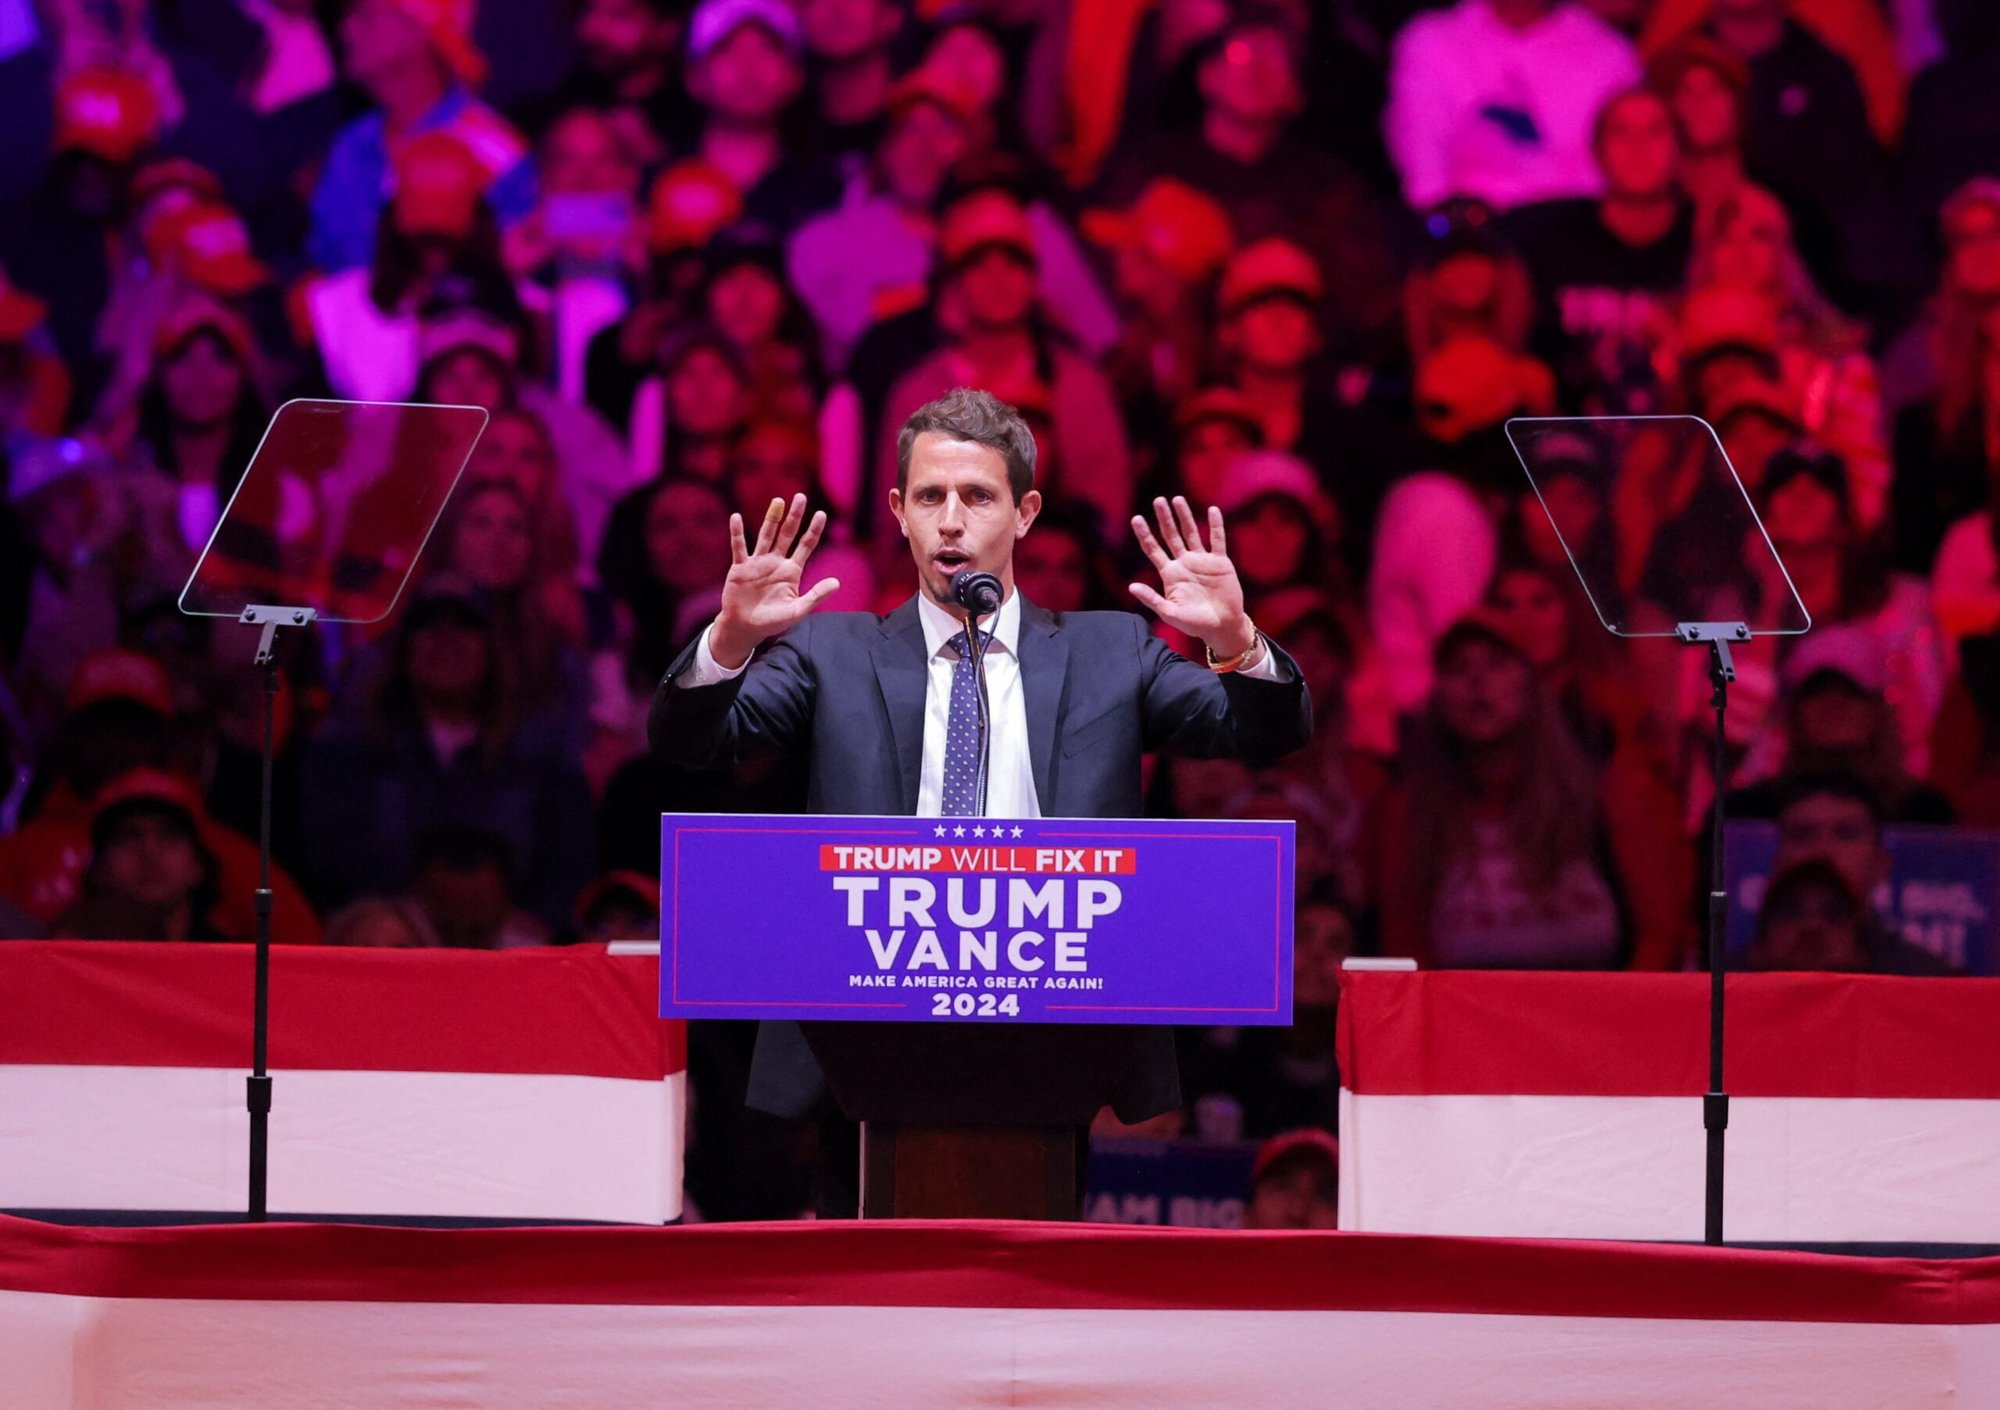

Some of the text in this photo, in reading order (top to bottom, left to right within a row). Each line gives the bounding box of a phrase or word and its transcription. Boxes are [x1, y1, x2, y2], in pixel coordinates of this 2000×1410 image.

[833, 846, 1123, 873] TRUMP WILL FIX IT
[832, 876, 1122, 929] TRUMP
[864, 929, 1088, 972] VANCE
[849, 975, 1103, 990] MAKE AMERICA GREAT AGAIN!
[931, 993, 1020, 1017] 2024
